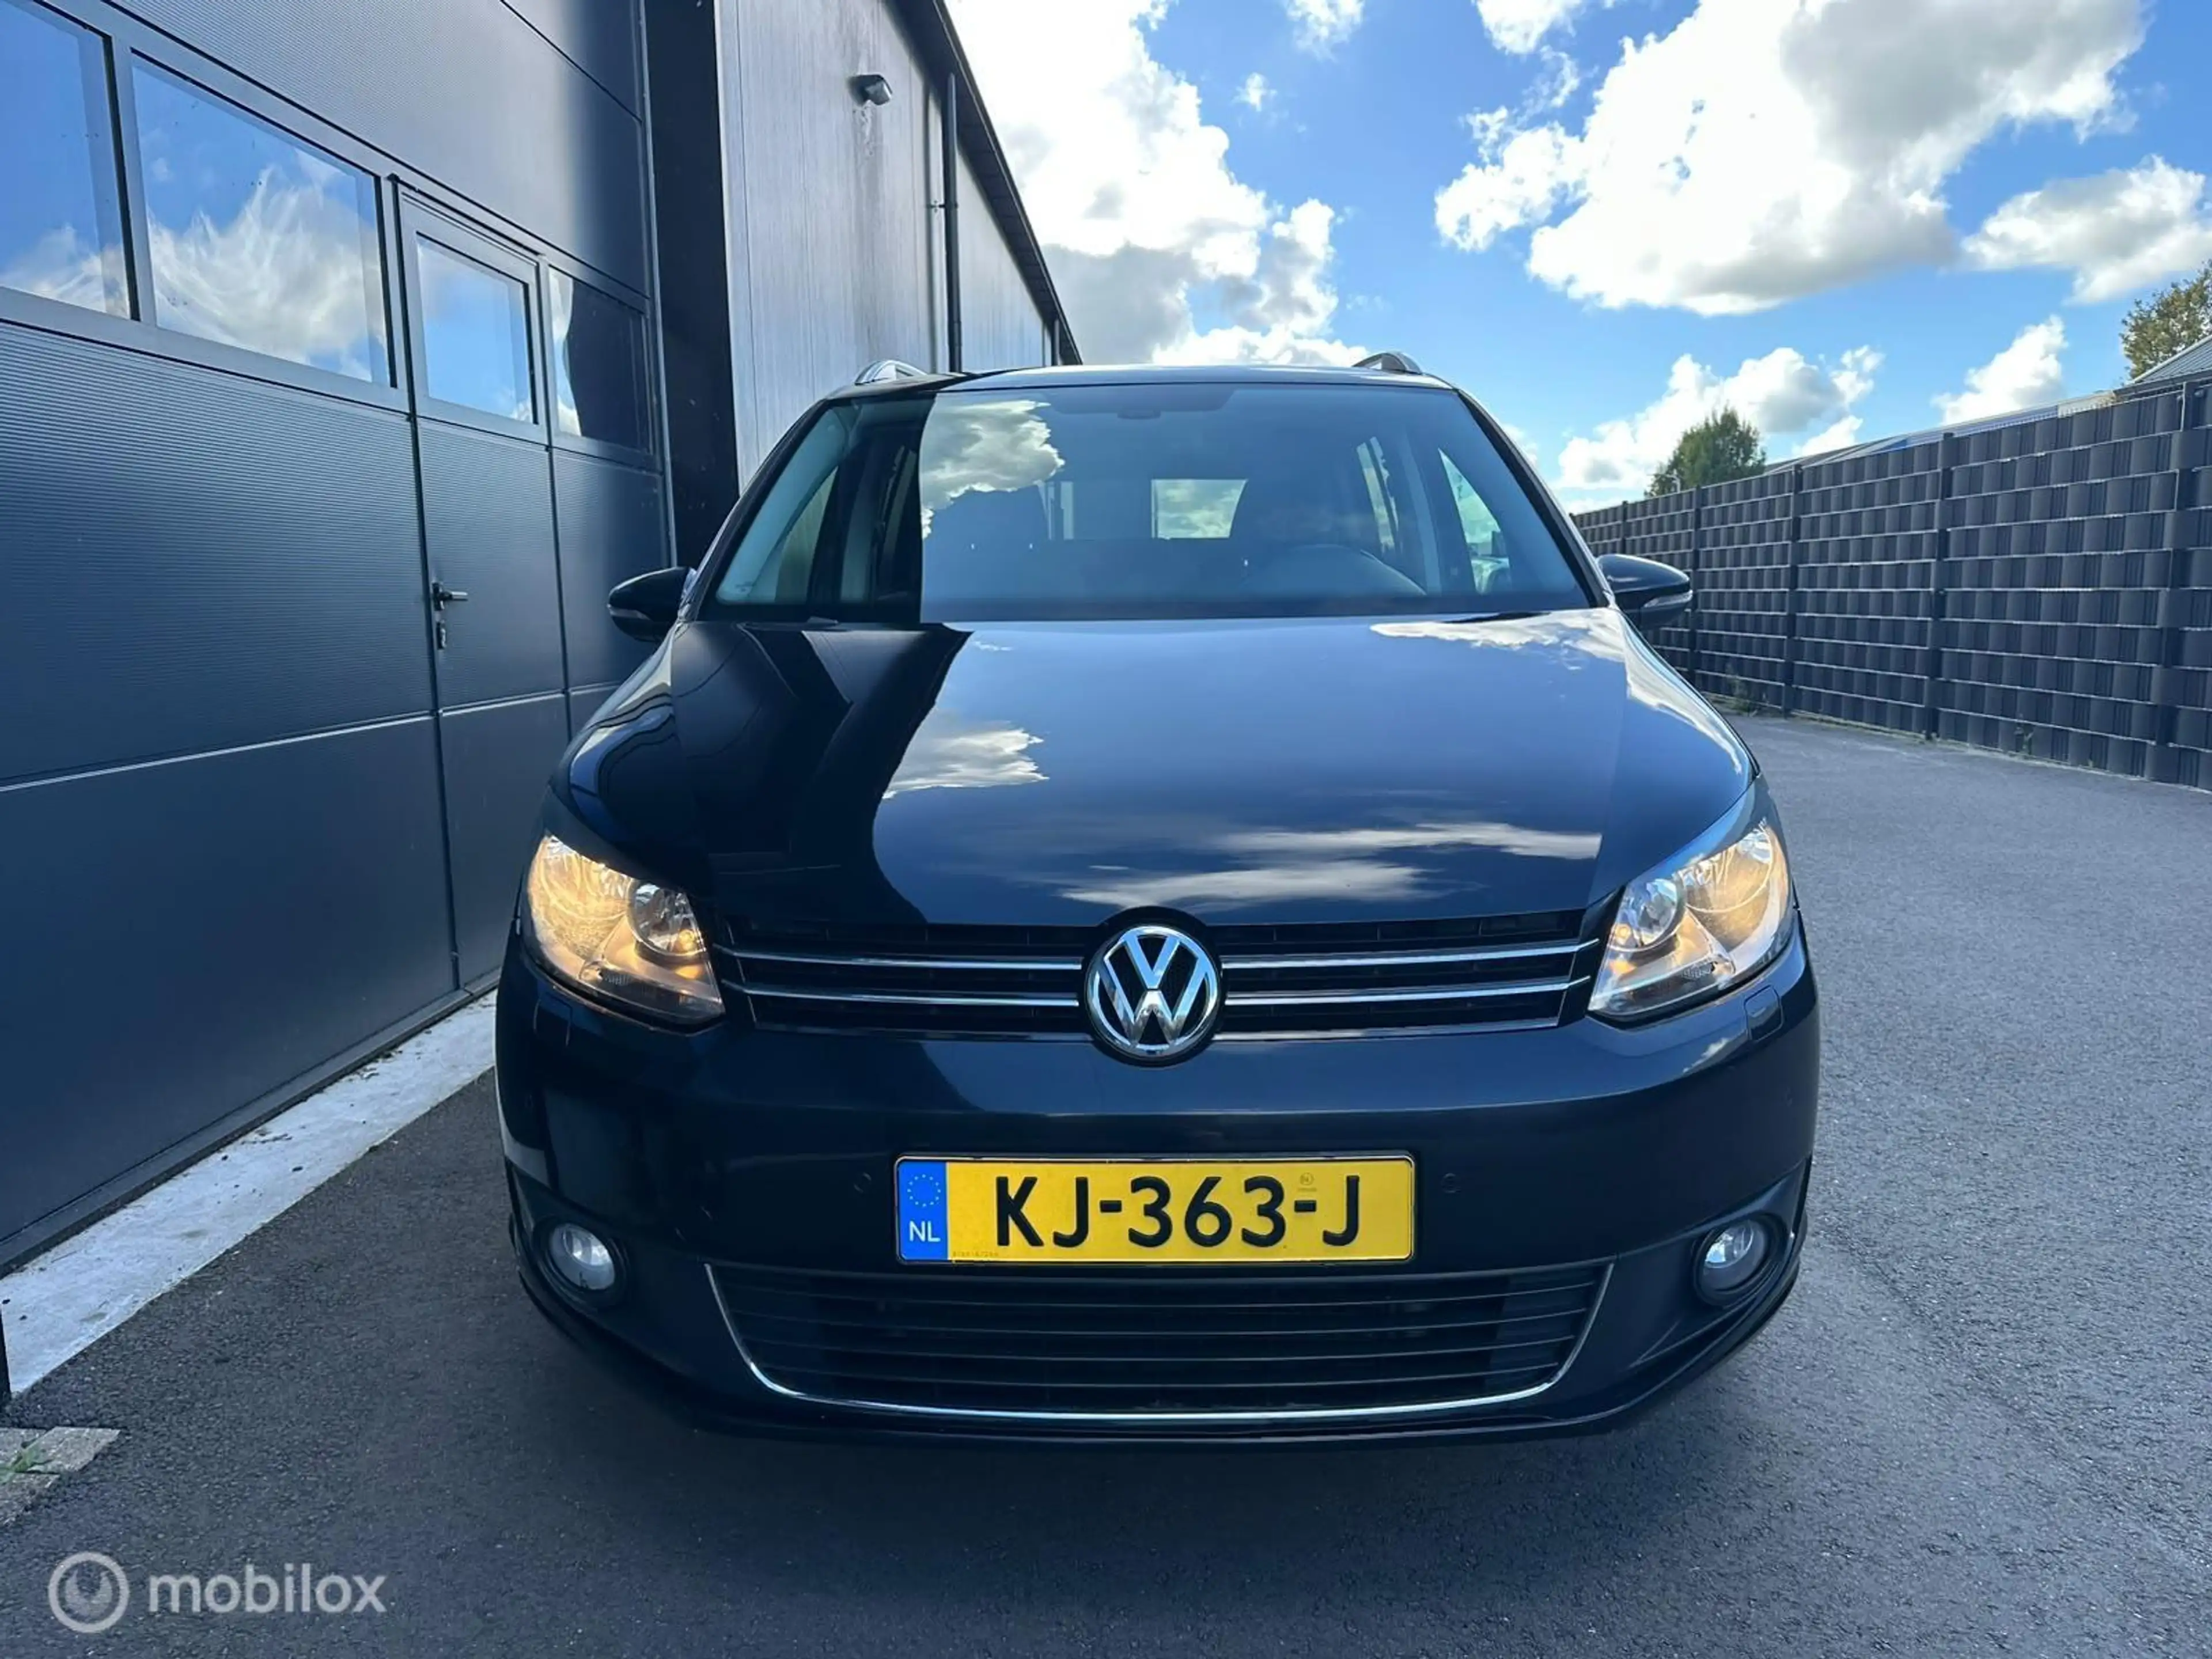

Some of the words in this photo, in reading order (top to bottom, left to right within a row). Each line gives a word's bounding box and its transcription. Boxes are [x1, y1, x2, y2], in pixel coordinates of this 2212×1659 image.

[1092, 929, 1213, 1052] VW
[909, 1221, 941, 1243] NL
[995, 1175, 1359, 1248] KJ-363-J
